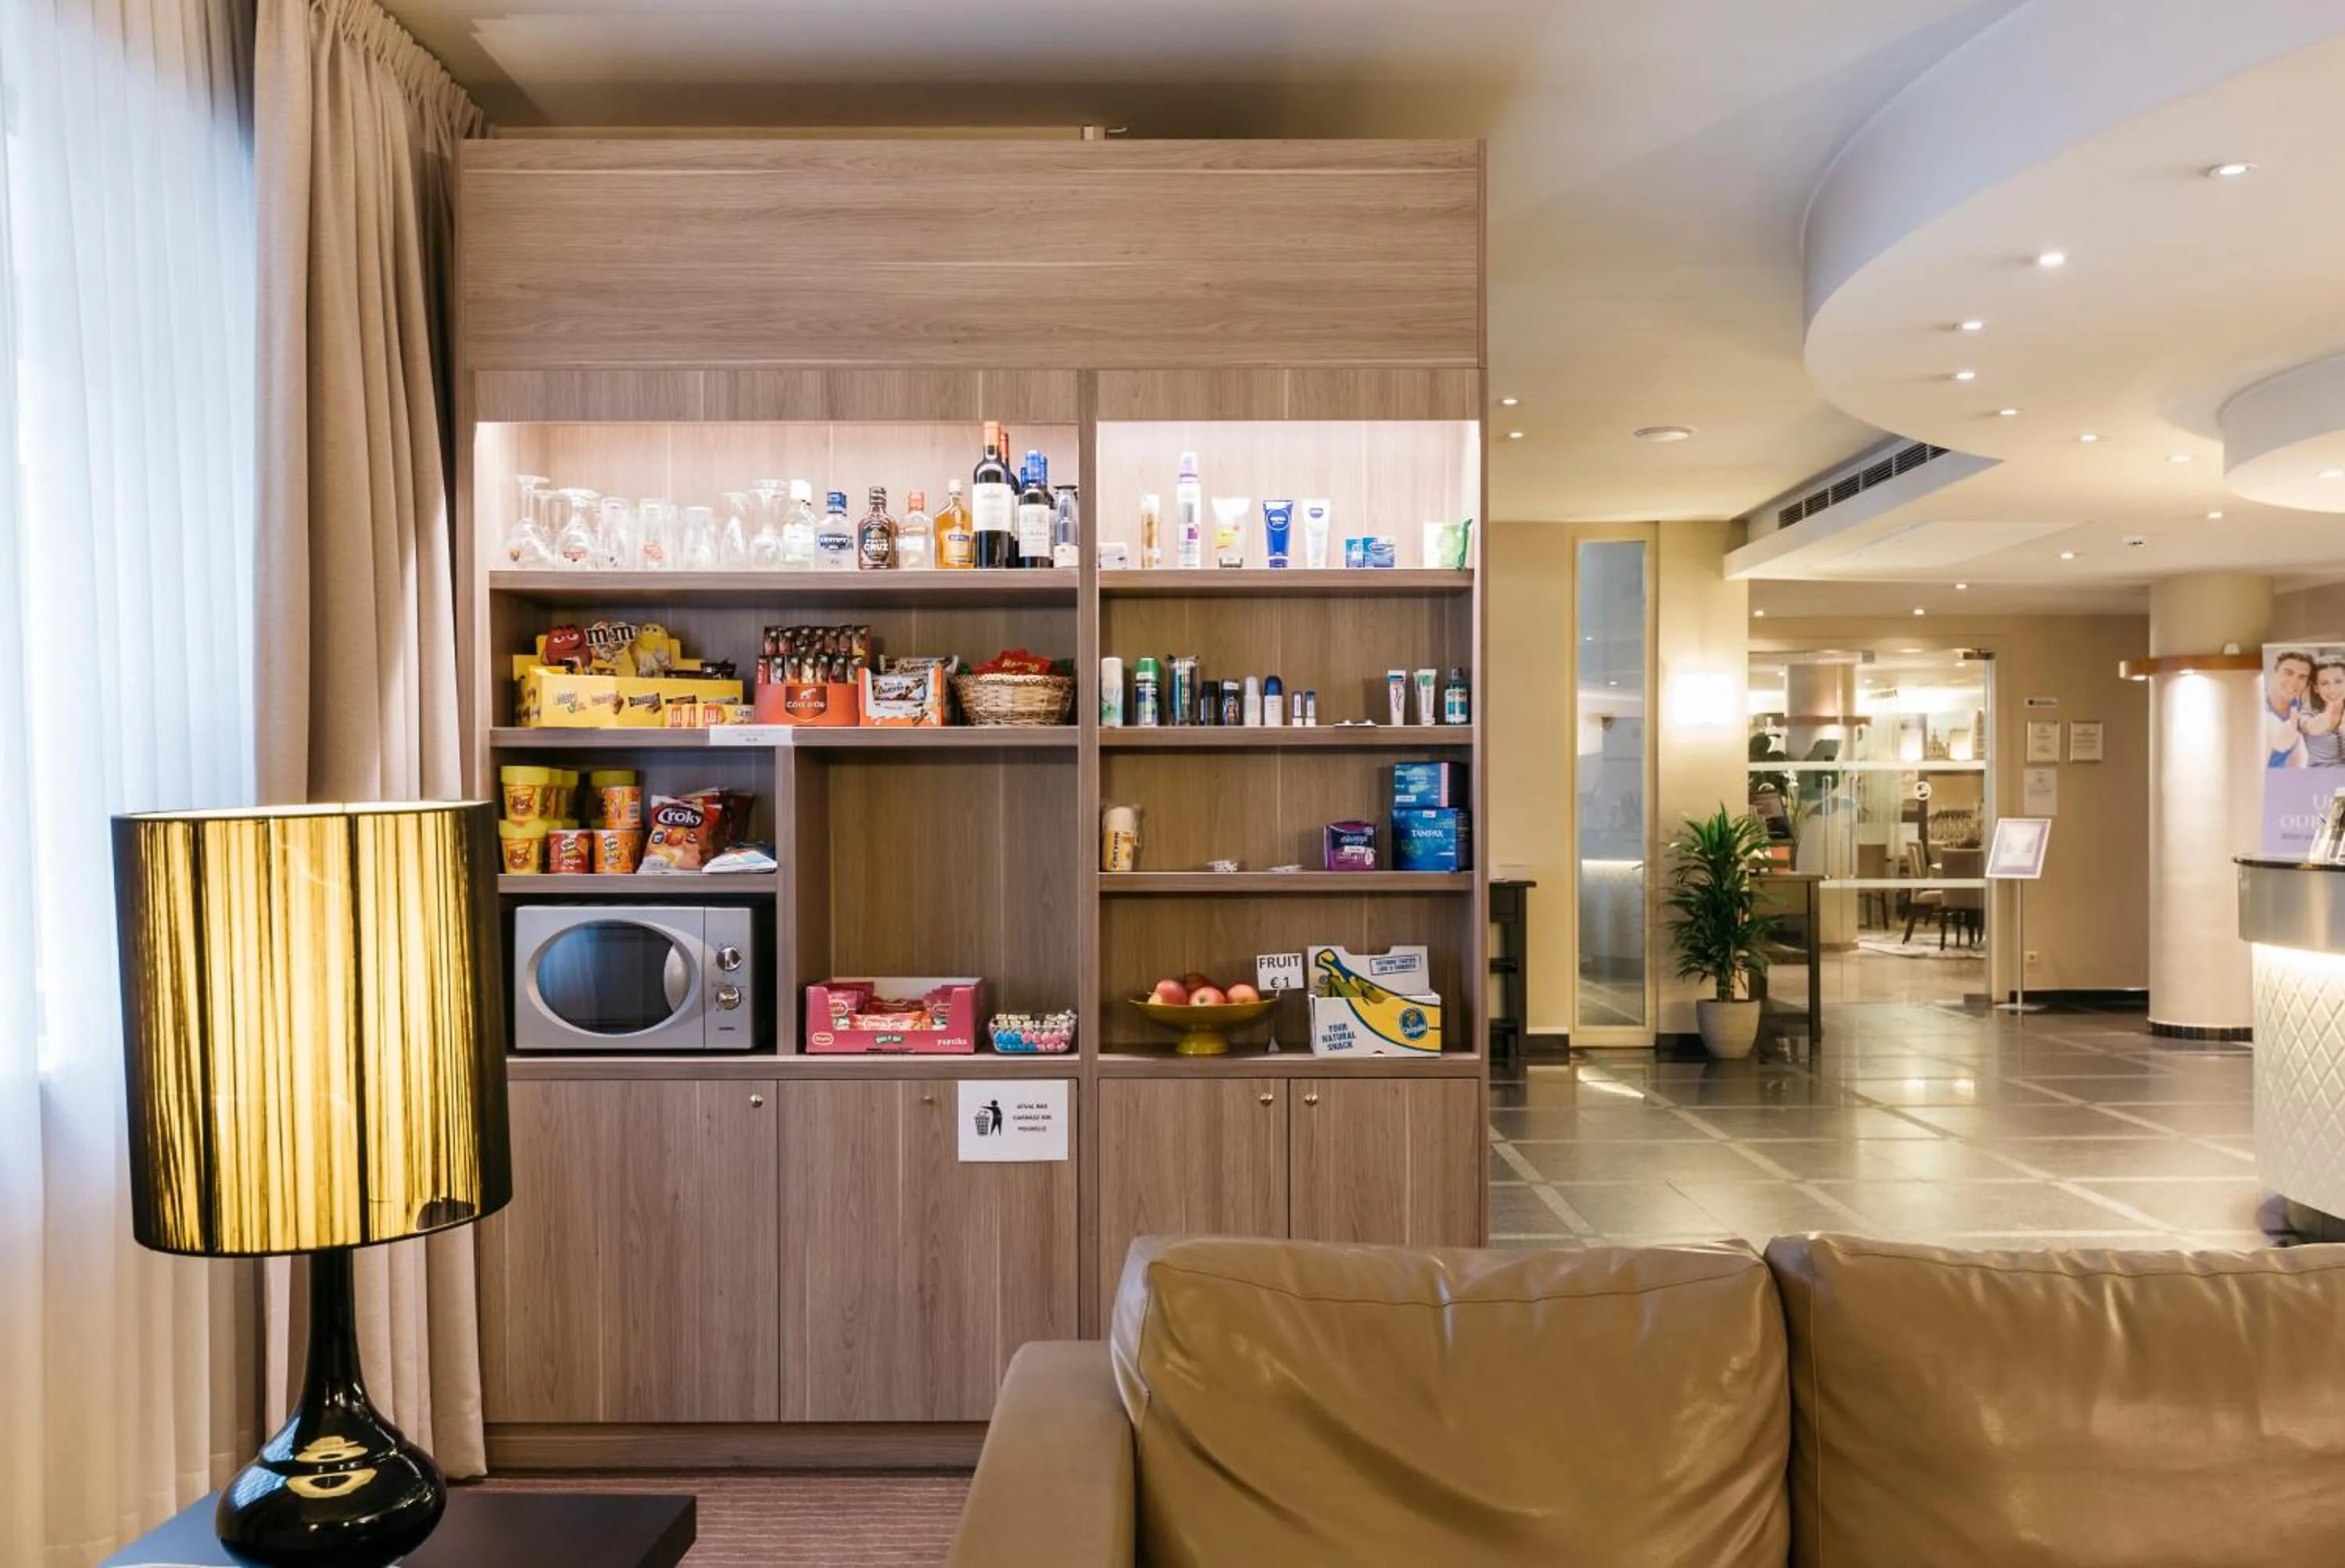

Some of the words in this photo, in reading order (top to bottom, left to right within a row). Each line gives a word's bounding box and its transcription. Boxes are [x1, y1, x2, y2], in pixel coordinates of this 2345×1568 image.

[657, 807, 702, 825] Croky
[1410, 829, 1445, 838] TAMPAX
[1258, 954, 1301, 969] FRUIT
[1283, 976, 1291, 988] 1
[1326, 1023, 1348, 1033] YOUR
[936, 1038, 968, 1047] paprika
[1321, 1031, 1357, 1043] NATURAL
[1326, 1041, 1353, 1051] SNACK
